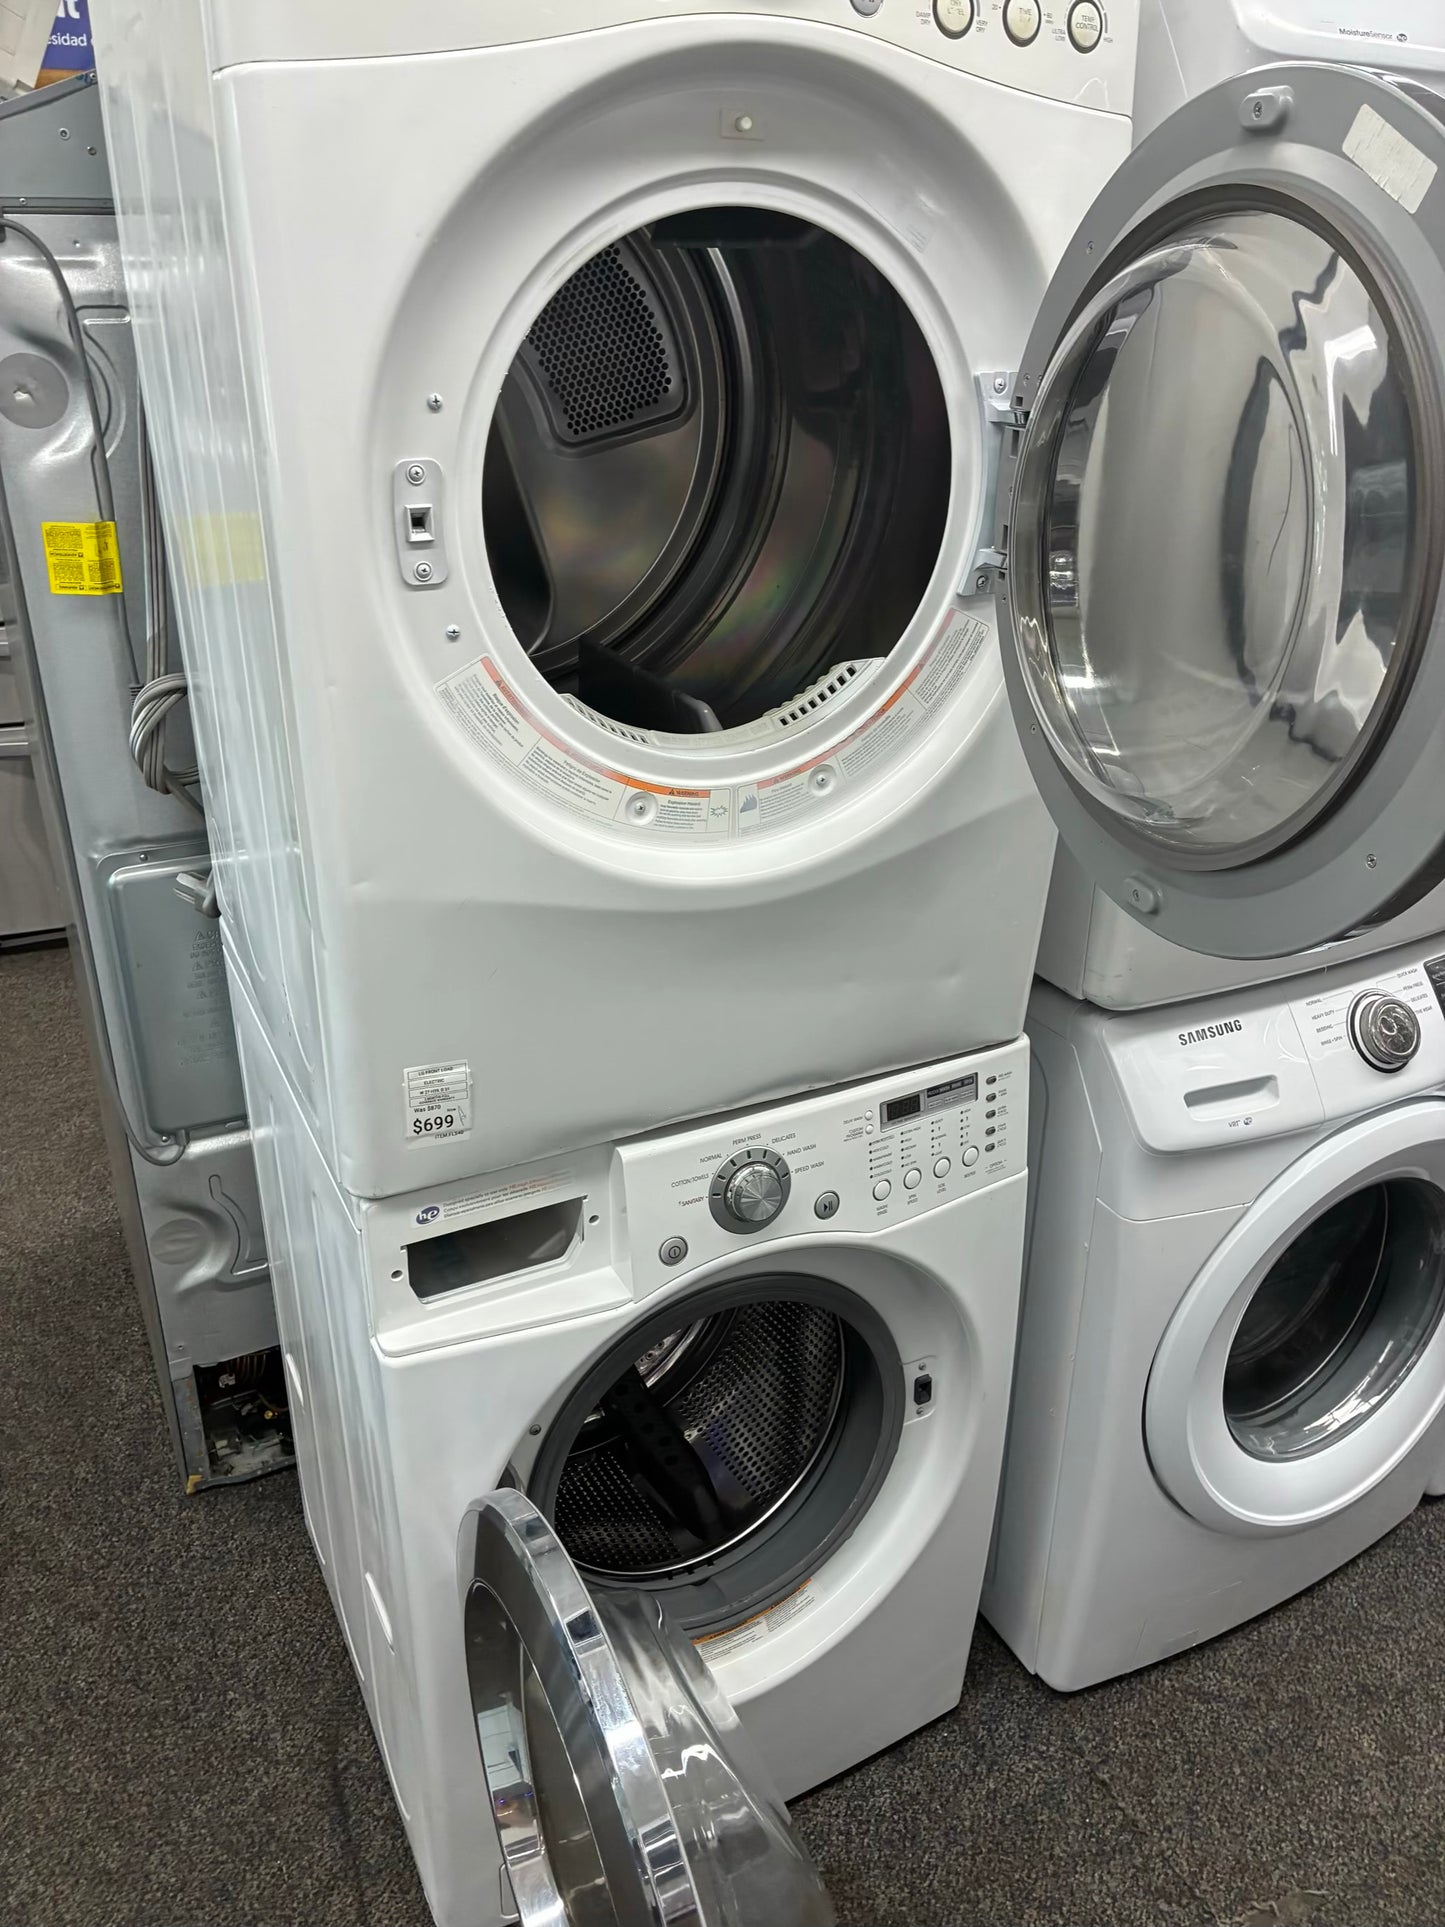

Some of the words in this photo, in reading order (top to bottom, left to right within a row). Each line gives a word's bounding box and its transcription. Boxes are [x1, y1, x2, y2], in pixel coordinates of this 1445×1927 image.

[1075, 22, 1099, 32] CONTROL
[1178, 1019, 1243, 1046] SAMSUNG
[413, 1114, 454, 1135] $699
[746, 1133, 762, 1142] PRESS
[771, 1132, 796, 1144] DELICATES
[802, 1143, 817, 1152] WASH
[700, 1153, 722, 1163] NORMAL
[794, 1164, 810, 1175] SPEED
[810, 1160, 825, 1169] WASH
